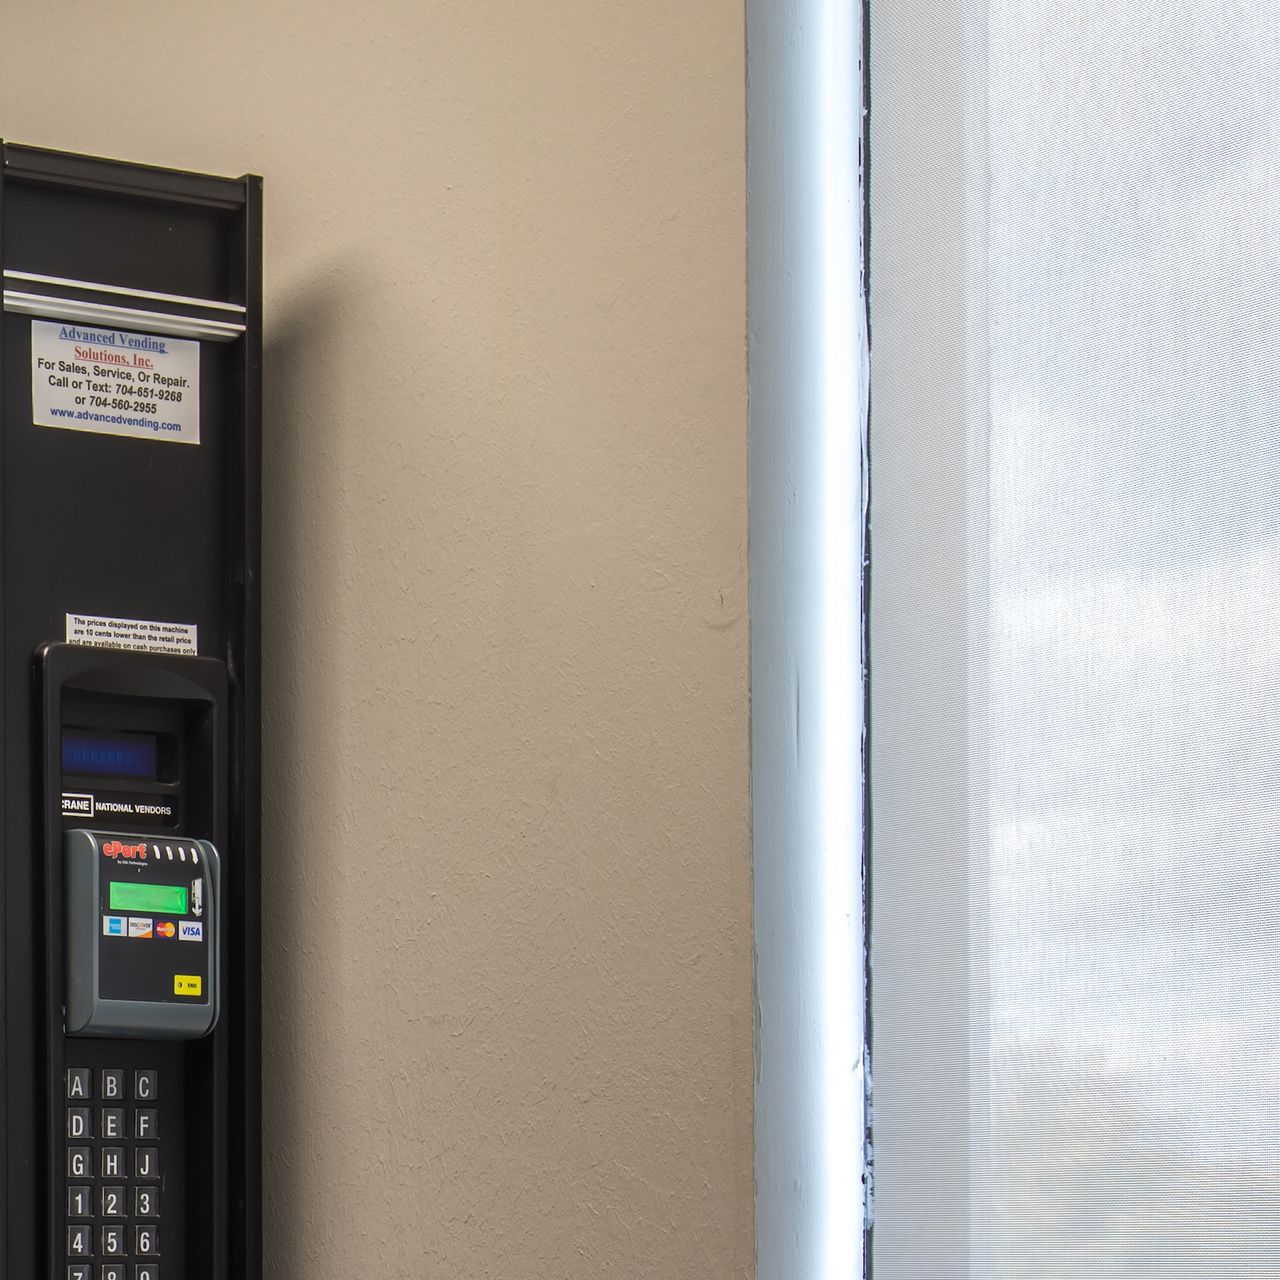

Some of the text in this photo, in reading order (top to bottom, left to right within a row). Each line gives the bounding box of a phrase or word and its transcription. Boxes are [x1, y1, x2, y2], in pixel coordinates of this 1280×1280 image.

[59, 326, 167, 353] Advanced Vending
[75, 347, 153, 367] Solutions, Inc.
[38, 358, 189, 388] For Sales, Service, Or Repair.
[49, 375, 182, 402] Call or Text: 704-651-9268
[75, 396, 156, 414] or 704-560-2955
[50, 409, 181, 431] www.advancedvending.com
[108, 621, 138, 630] displayed
[95, 801, 133, 813] NATIONAL
[135, 804, 171, 815] VENDORS
[103, 841, 147, 859] ePort
[182, 926, 200, 936] VISA
[71, 1076, 149, 1097] A B C
[73, 1116, 149, 1136] D E F
[75, 1194, 150, 1214] 1 2 3
